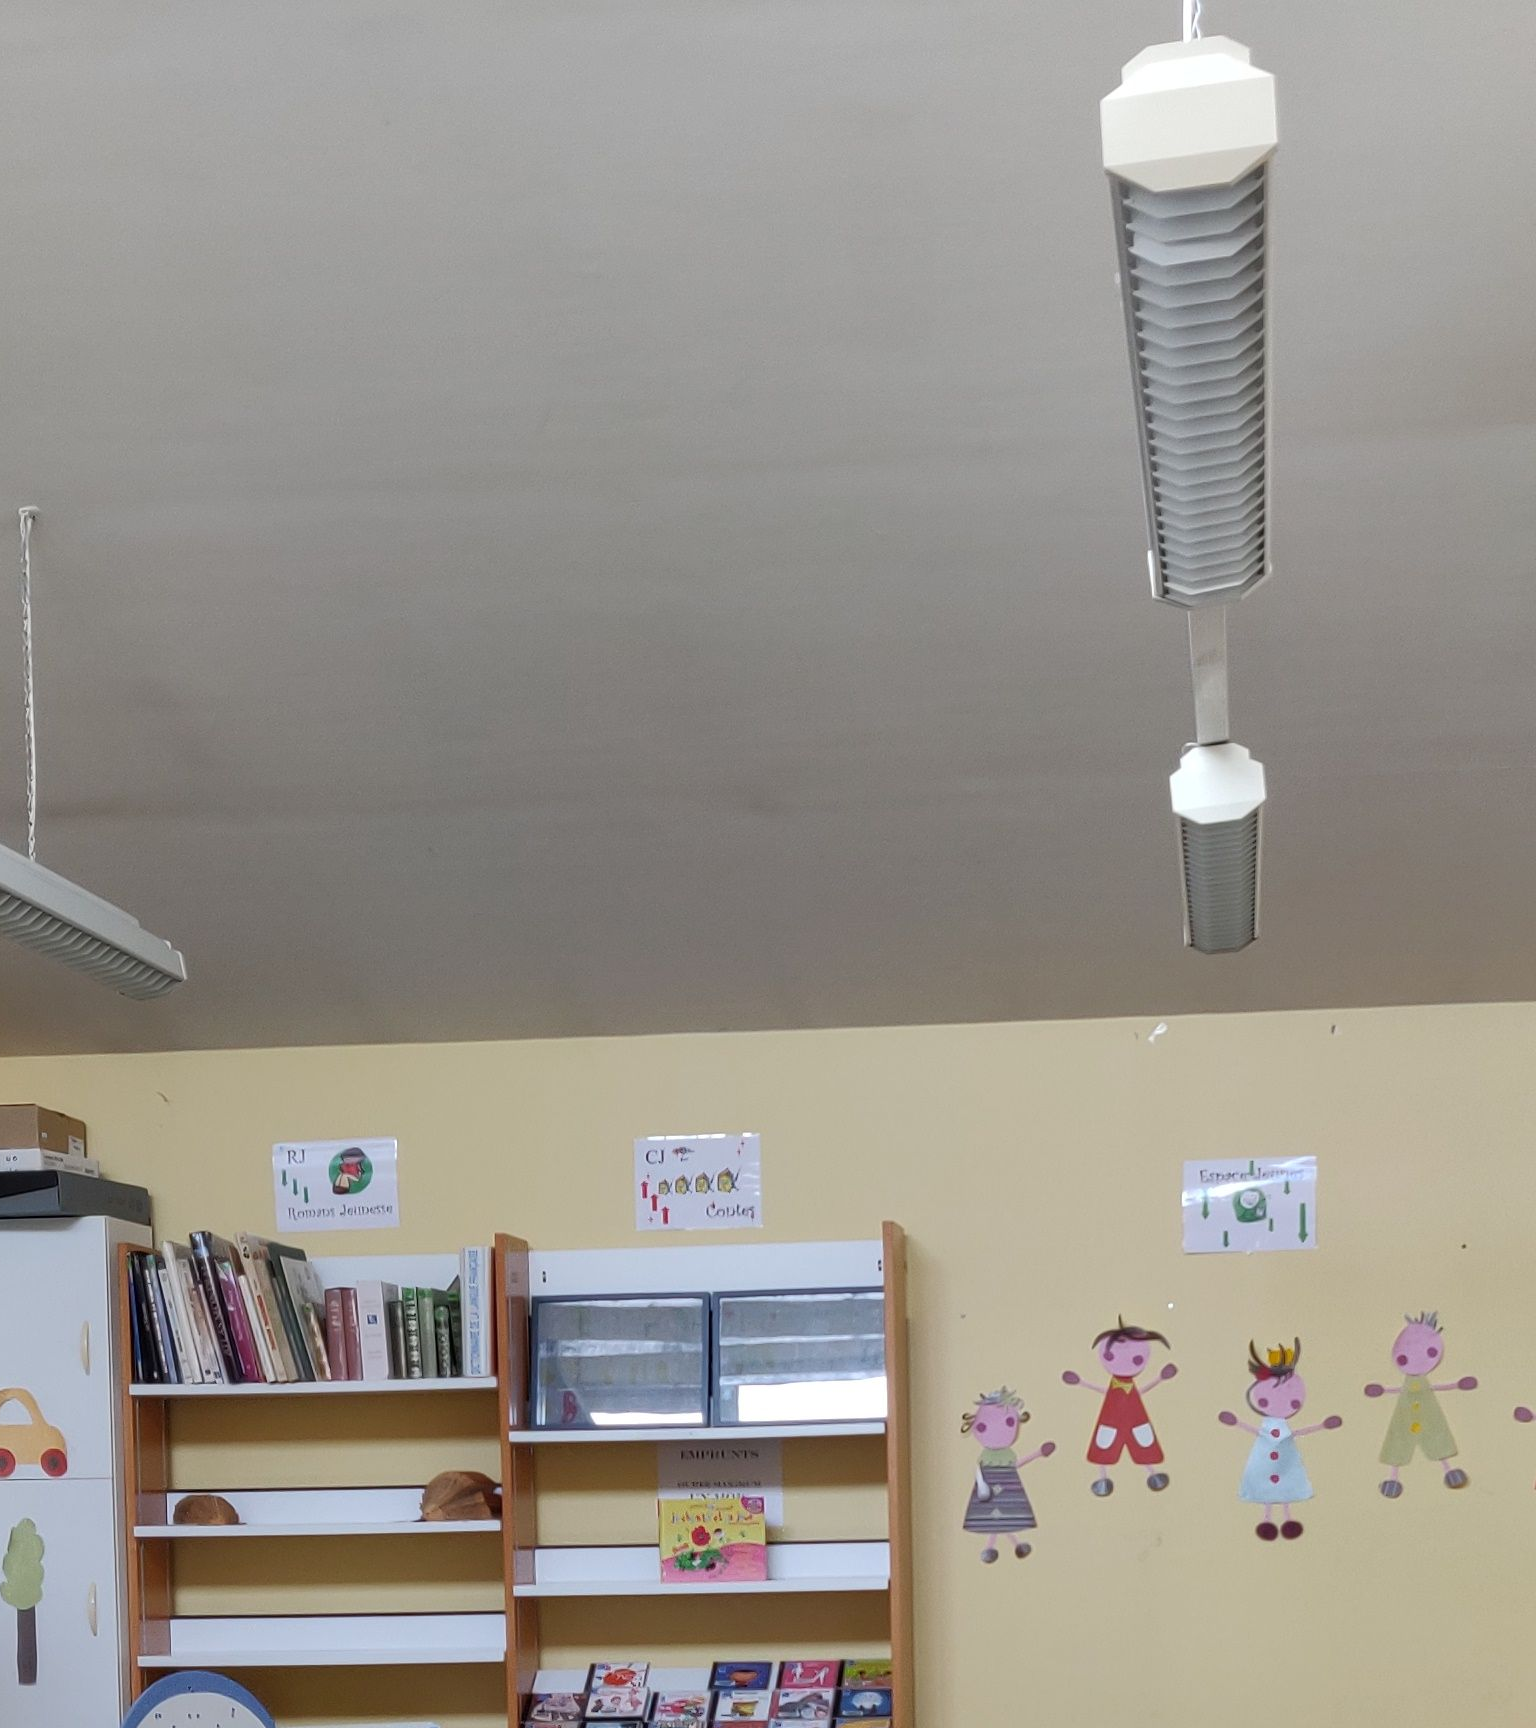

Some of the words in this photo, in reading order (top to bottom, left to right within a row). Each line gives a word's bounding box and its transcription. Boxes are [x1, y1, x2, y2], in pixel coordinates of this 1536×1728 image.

[287, 1149, 305, 1165] RJ
[645, 1149, 665, 1164] CJ
[288, 1205, 336, 1220] Romans
[340, 1203, 393, 1217] Jeunesse
[706, 1201, 755, 1220] Contes
[680, 1450, 760, 1460] EMPRUNTS
